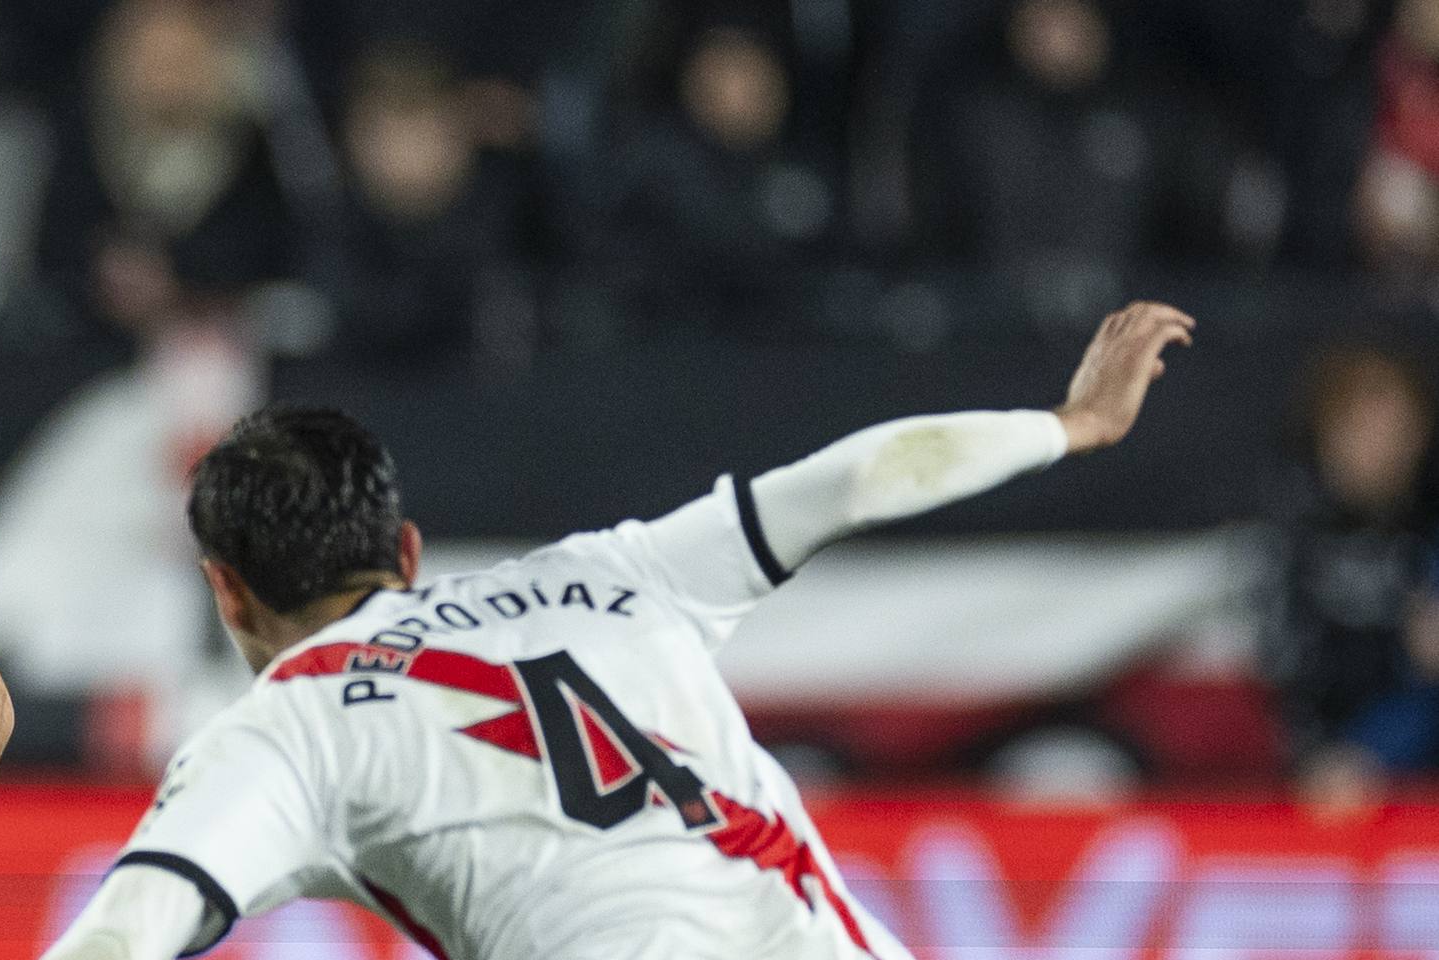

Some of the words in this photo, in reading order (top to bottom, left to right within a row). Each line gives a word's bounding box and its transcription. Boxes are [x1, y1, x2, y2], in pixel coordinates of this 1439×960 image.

[343, 602, 481, 706] PEDRO
[484, 578, 638, 619] DÍAZ
[511, 649, 720, 831] 4
